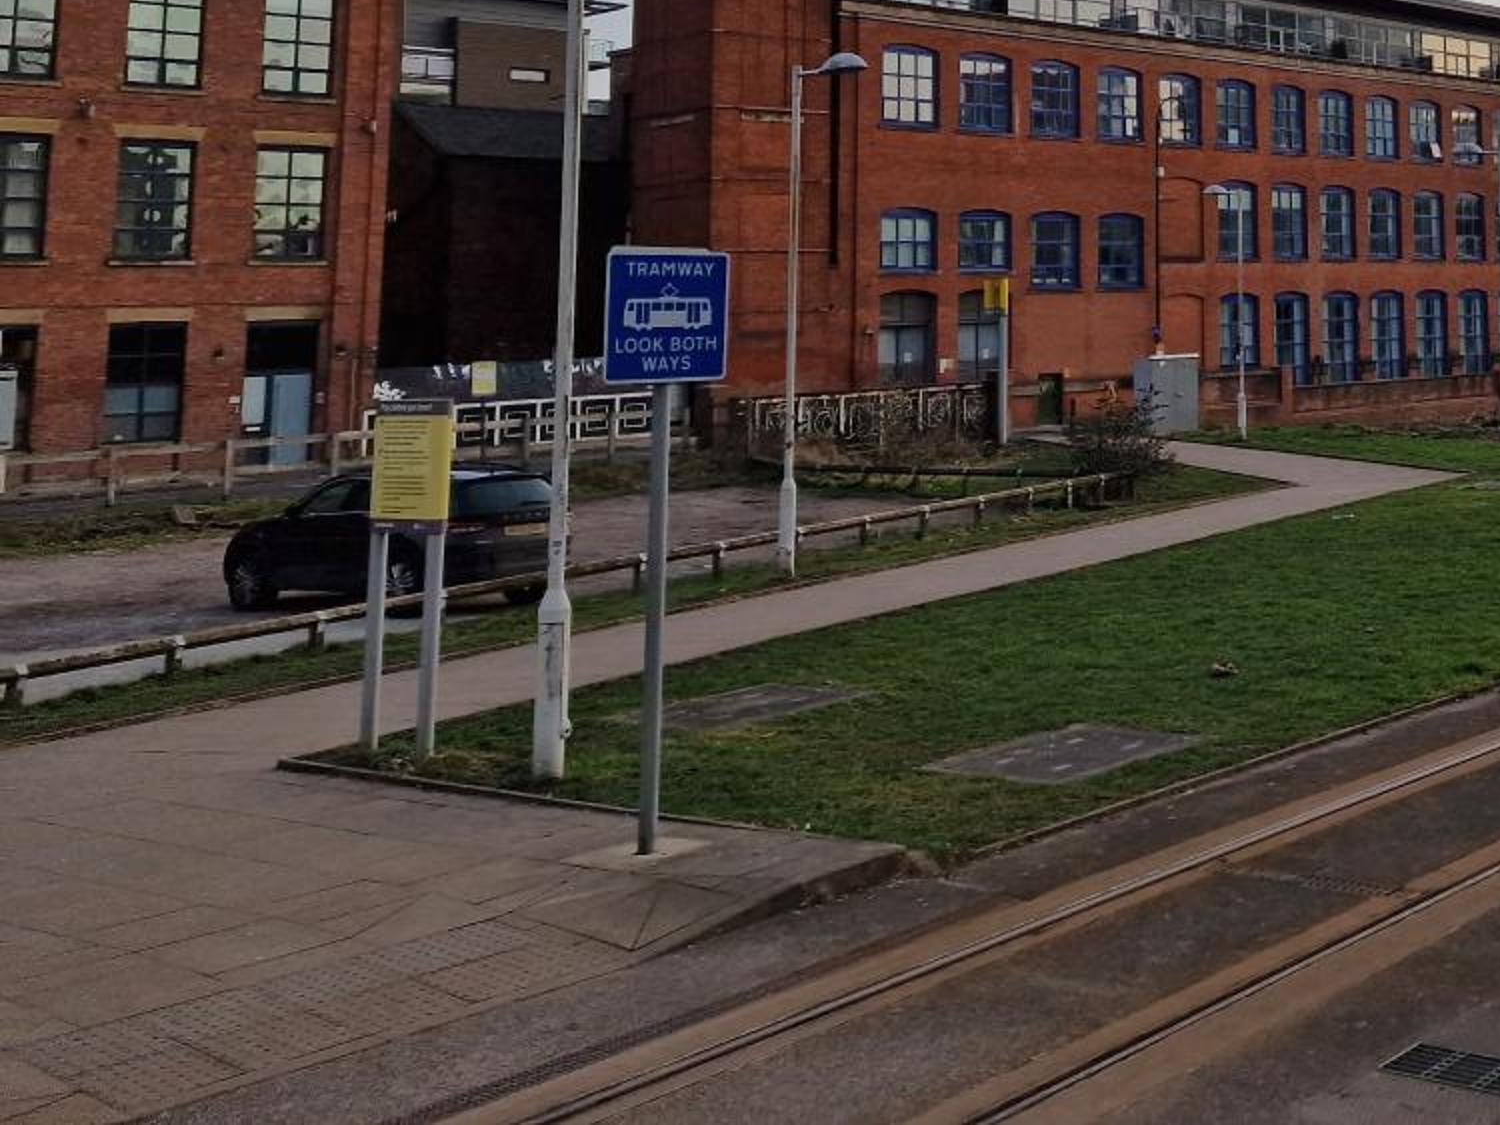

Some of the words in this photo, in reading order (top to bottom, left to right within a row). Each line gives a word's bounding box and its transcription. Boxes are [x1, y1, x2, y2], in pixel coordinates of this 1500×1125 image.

[626, 261, 716, 277] TRAMWAY
[615, 338, 664, 354] LOOK
[670, 336, 717, 351] BOTH
[642, 355, 692, 372] WAYS
